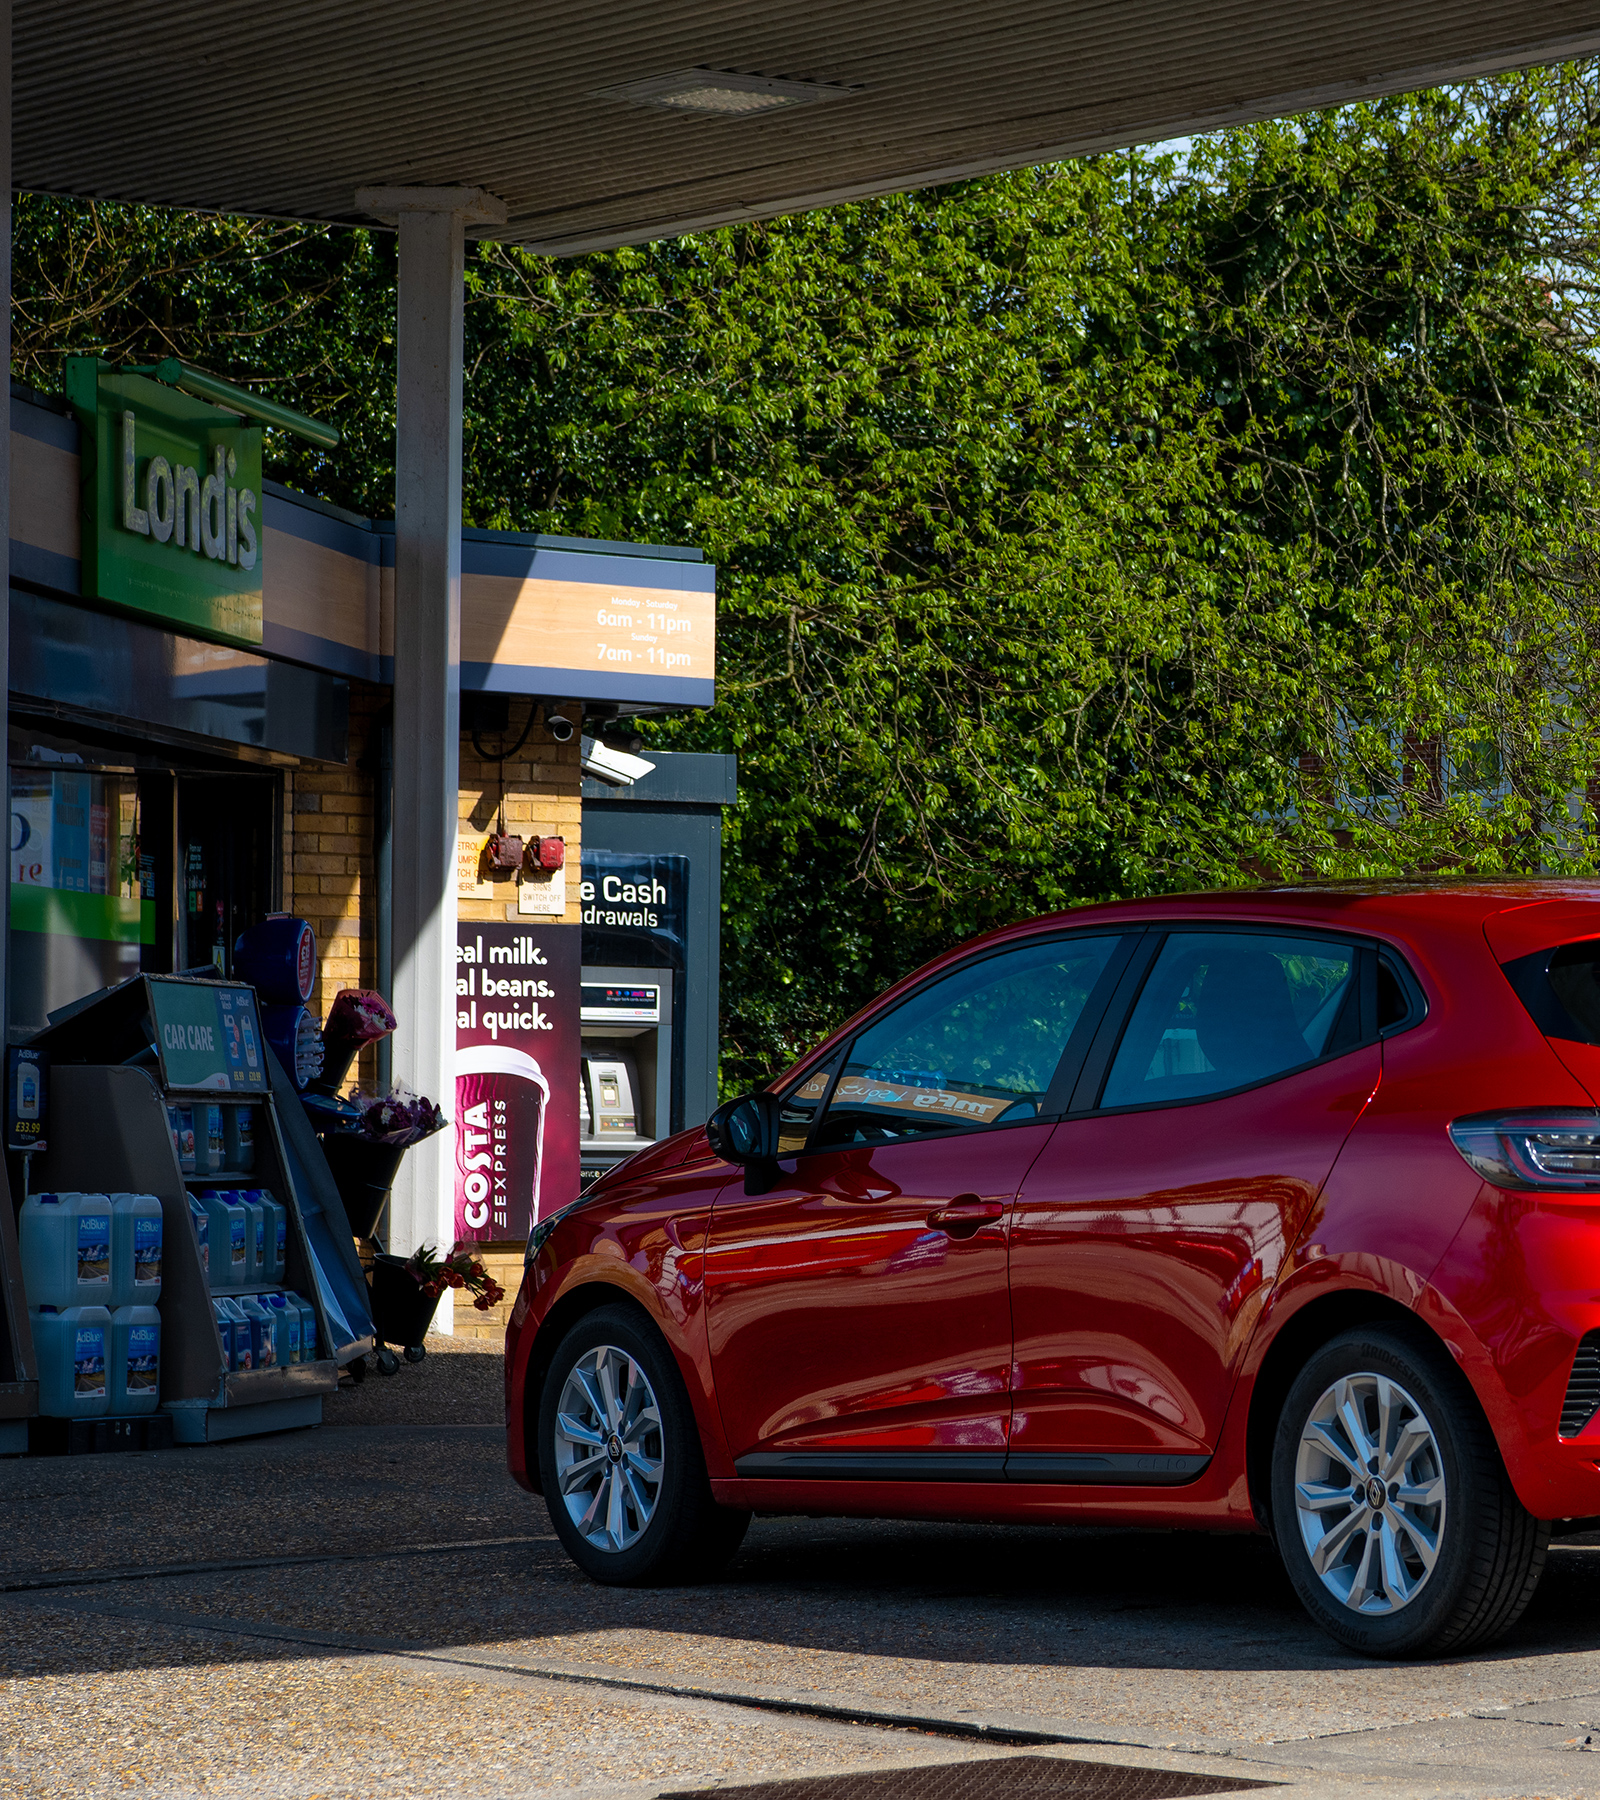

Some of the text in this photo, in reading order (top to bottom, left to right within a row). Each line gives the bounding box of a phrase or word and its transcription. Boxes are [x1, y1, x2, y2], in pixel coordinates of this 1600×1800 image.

[123, 410, 258, 571] Londis
[611, 597, 678, 611] Monday Saturday
[597, 609, 692, 635] 6am 11pm
[631, 632, 658, 645] Sunday
[597, 643, 691, 669] 7am 11pm
[458, 841, 479, 852] ETROL
[458, 855, 478, 865] UMPS
[533, 883, 552, 893] SIGNS
[602, 875, 667, 905] Cash
[523, 893, 562, 902] SWITCH OFF
[533, 904, 551, 913] HERE
[489, 936, 548, 966] milk.
[481, 967, 556, 998] beans.
[482, 1002, 554, 1041] quick.
[163, 1023, 215, 1052] CAR CARE
[15, 1122, 41, 1134] £33.99
[494, 1100, 508, 1207] EXPRESS
[463, 1101, 493, 1229] COSTA
[80, 1219, 107, 1231] AdBlue
[136, 1221, 159, 1233] AdBlue
[76, 1331, 101, 1344] AdBlue
[130, 1329, 155, 1342] AdBlue
